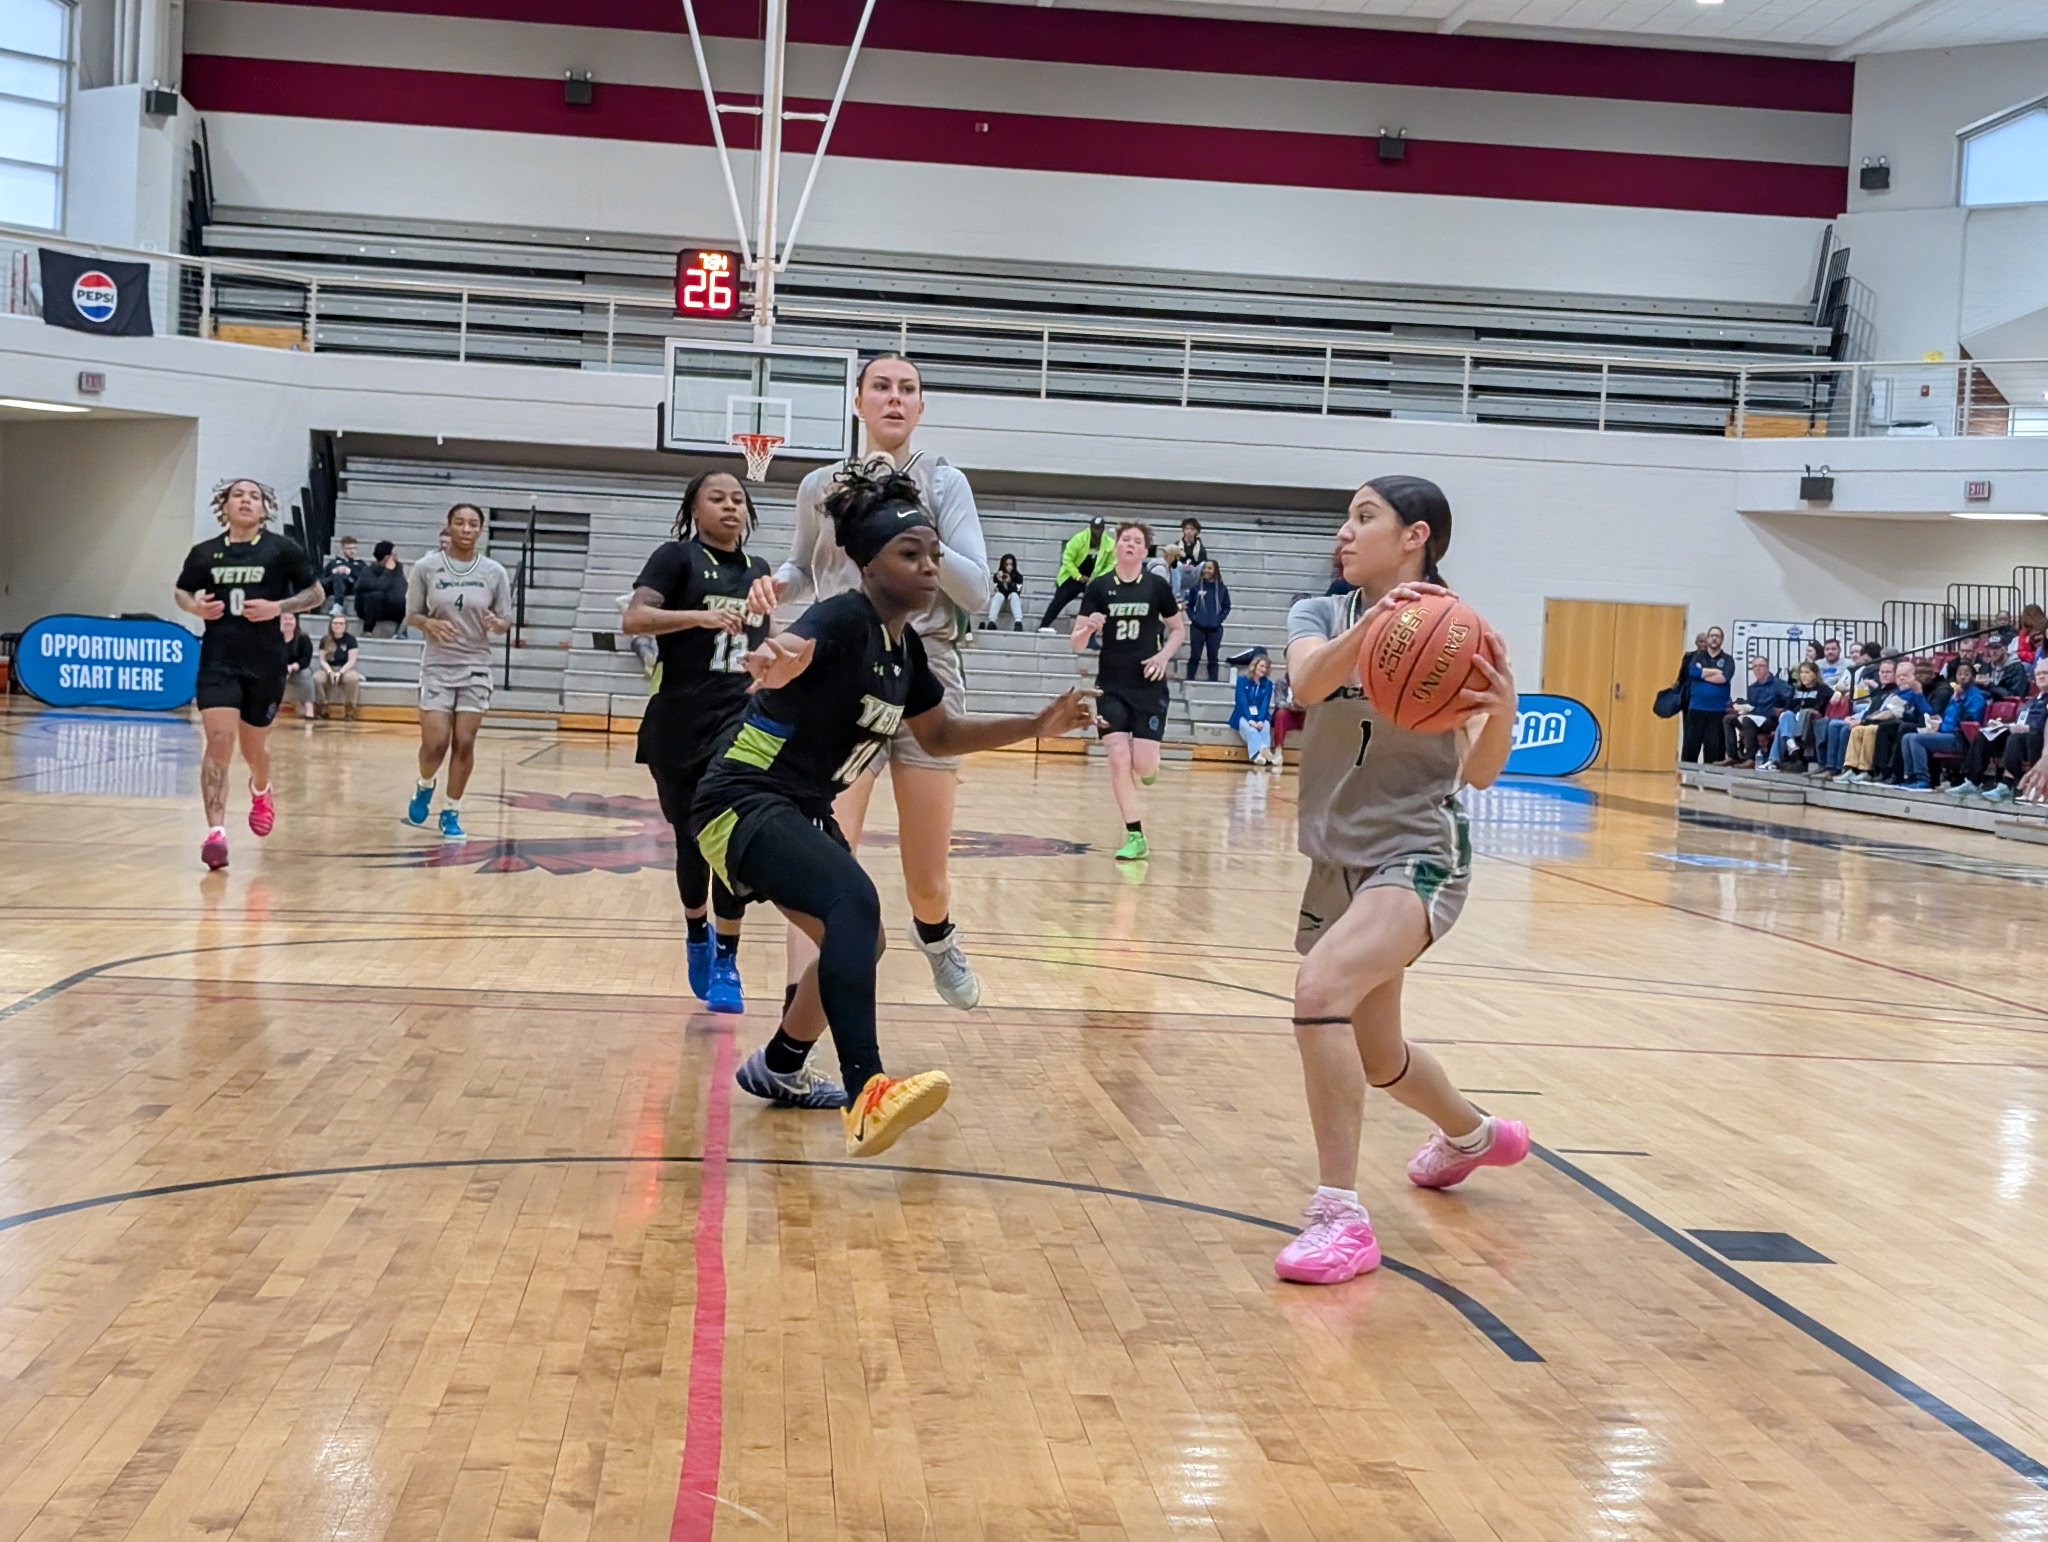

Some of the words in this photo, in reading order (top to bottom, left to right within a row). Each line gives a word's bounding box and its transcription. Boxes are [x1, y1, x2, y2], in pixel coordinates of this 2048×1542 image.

[76, 289, 114, 303] PEPSI
[683, 268, 732, 310] 26
[210, 565, 266, 585] YETIS
[229, 587, 246, 616] 0
[454, 593, 464, 611] 4
[1107, 602, 1150, 617] YETIS
[1115, 619, 1141, 641] 20
[1384, 607, 1432, 682] LEGACY
[40, 632, 184, 663] OPPORTUNITIES
[709, 631, 750, 673] 12
[1411, 618, 1471, 704] SPALDING
[59, 663, 114, 690] START
[117, 666, 165, 692] HERE
[1354, 719, 1372, 767] 1
